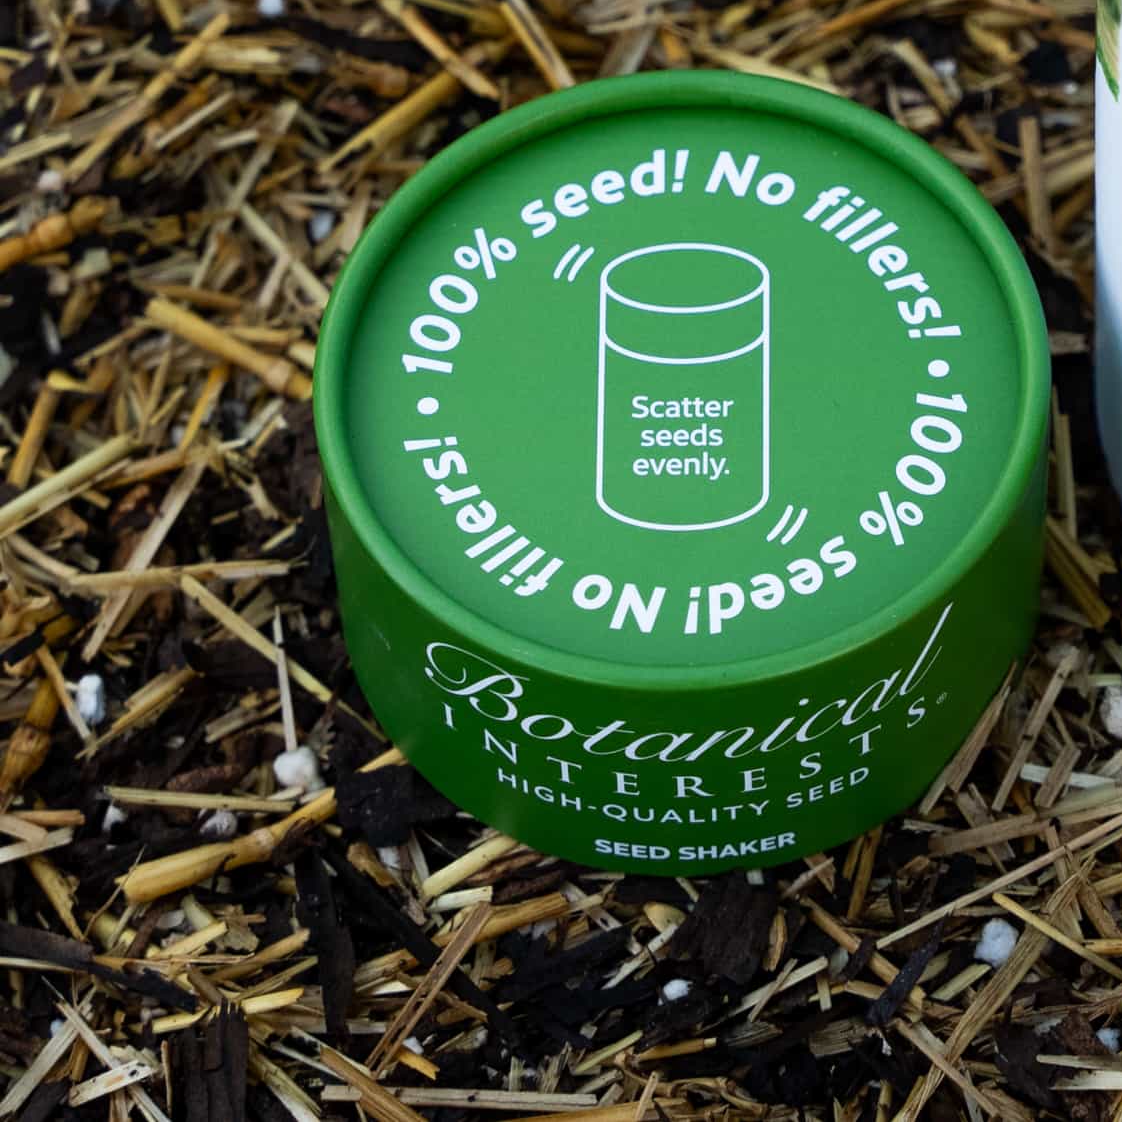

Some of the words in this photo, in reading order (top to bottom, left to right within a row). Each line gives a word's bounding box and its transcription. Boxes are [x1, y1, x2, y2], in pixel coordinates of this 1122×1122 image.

[402, 227, 518, 375] 100%
[521, 149, 691, 239] seed!
[704, 149, 796, 206] No
[803, 186, 963, 339] fillers!
[631, 395, 734, 419] Scatter
[640, 422, 724, 447] seeds
[632, 450, 730, 481] evenly.
[860, 392, 968, 546] 100%
[403, 436, 564, 597] fillers!
[571, 573, 667, 634] No
[683, 535, 858, 635] seed!
[424, 602, 953, 763] Botanical
[497, 767, 769, 824] HIGH-QUALITY
[786, 765, 870, 809] SEED
[594, 838, 671, 860] SEED
[678, 831, 797, 860] SHAKER
